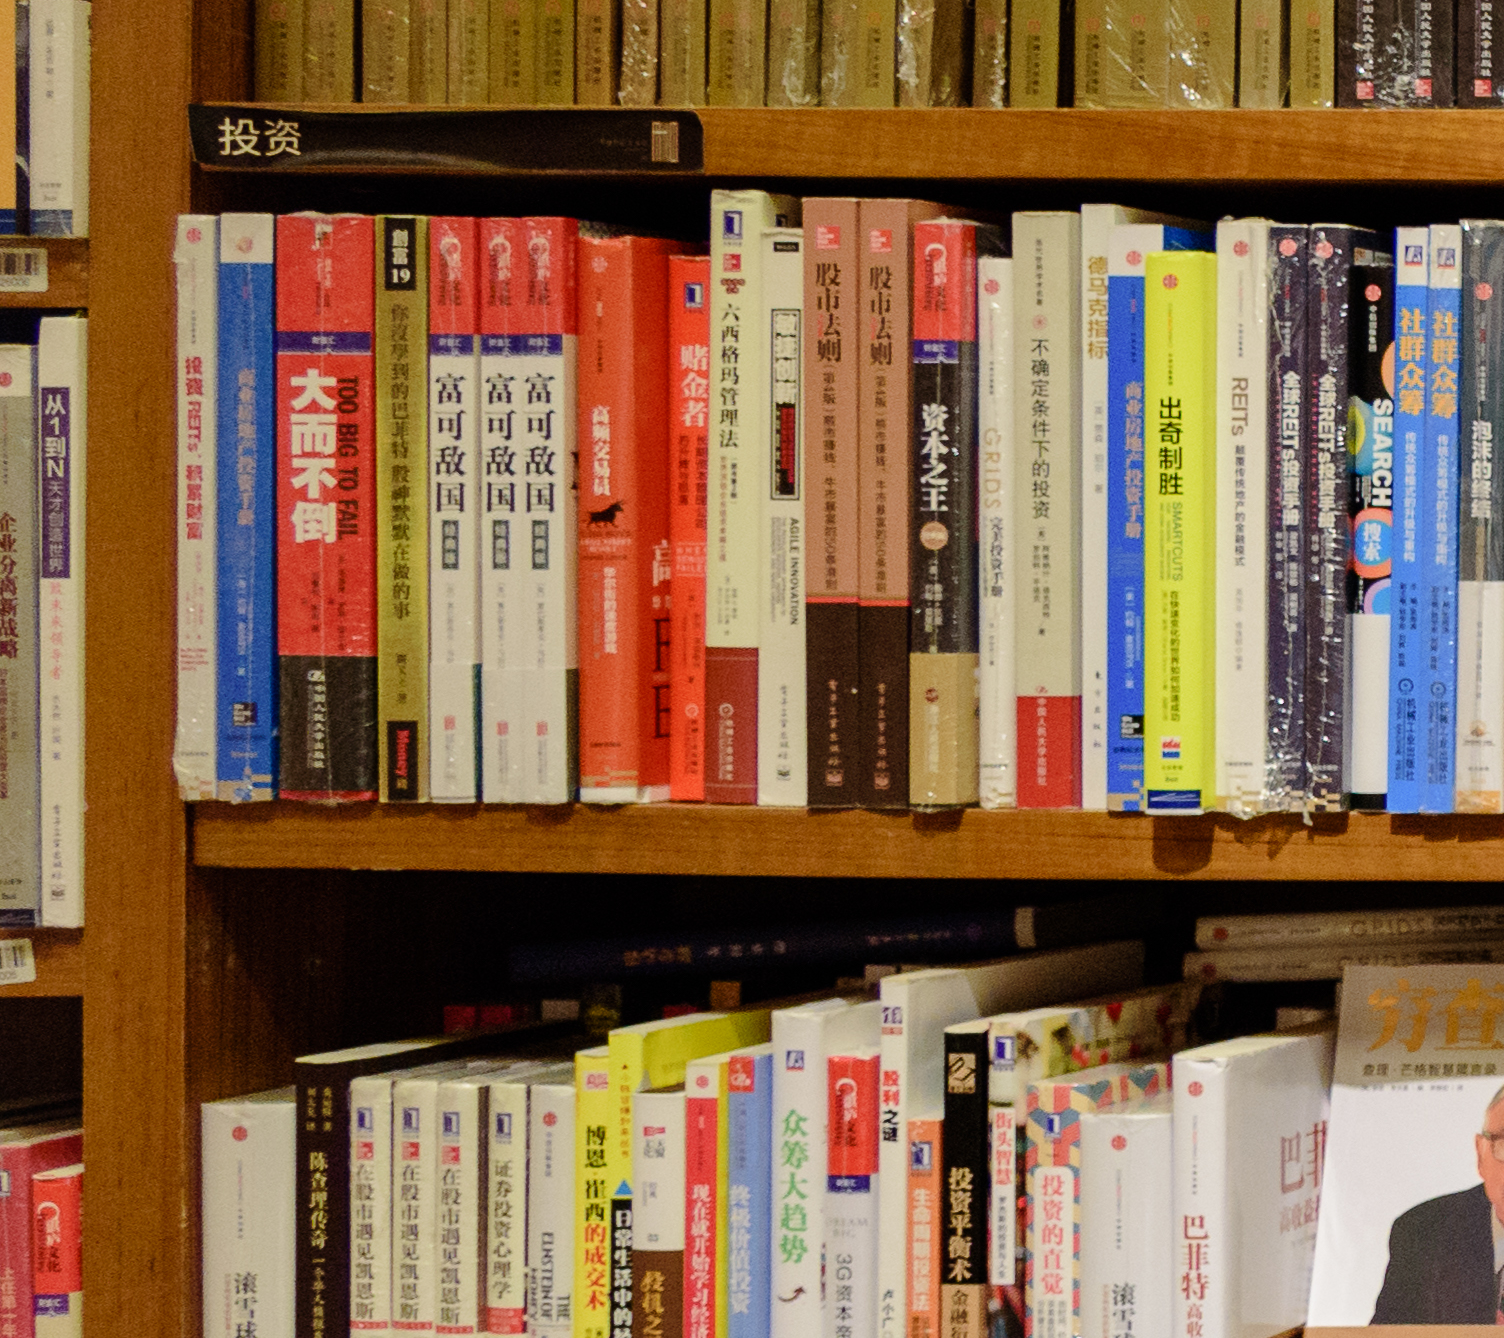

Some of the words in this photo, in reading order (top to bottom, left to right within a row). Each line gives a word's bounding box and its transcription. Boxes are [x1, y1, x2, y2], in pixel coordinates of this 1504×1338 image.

[218, 118, 302, 157] 投资
[42, 393, 67, 477] 从1到N
[290, 369, 336, 543] 大而不倒
[436, 373, 466, 514] 富可敌国
[1031, 339, 1050, 519] 不确定条件下的投资
[1159, 397, 1184, 495] 出奇制胜
[1232, 378, 1248, 436] REITs
[1372, 397, 1392, 508] SEARCH
[782, 1110, 809, 1265] 众筹大趋势
